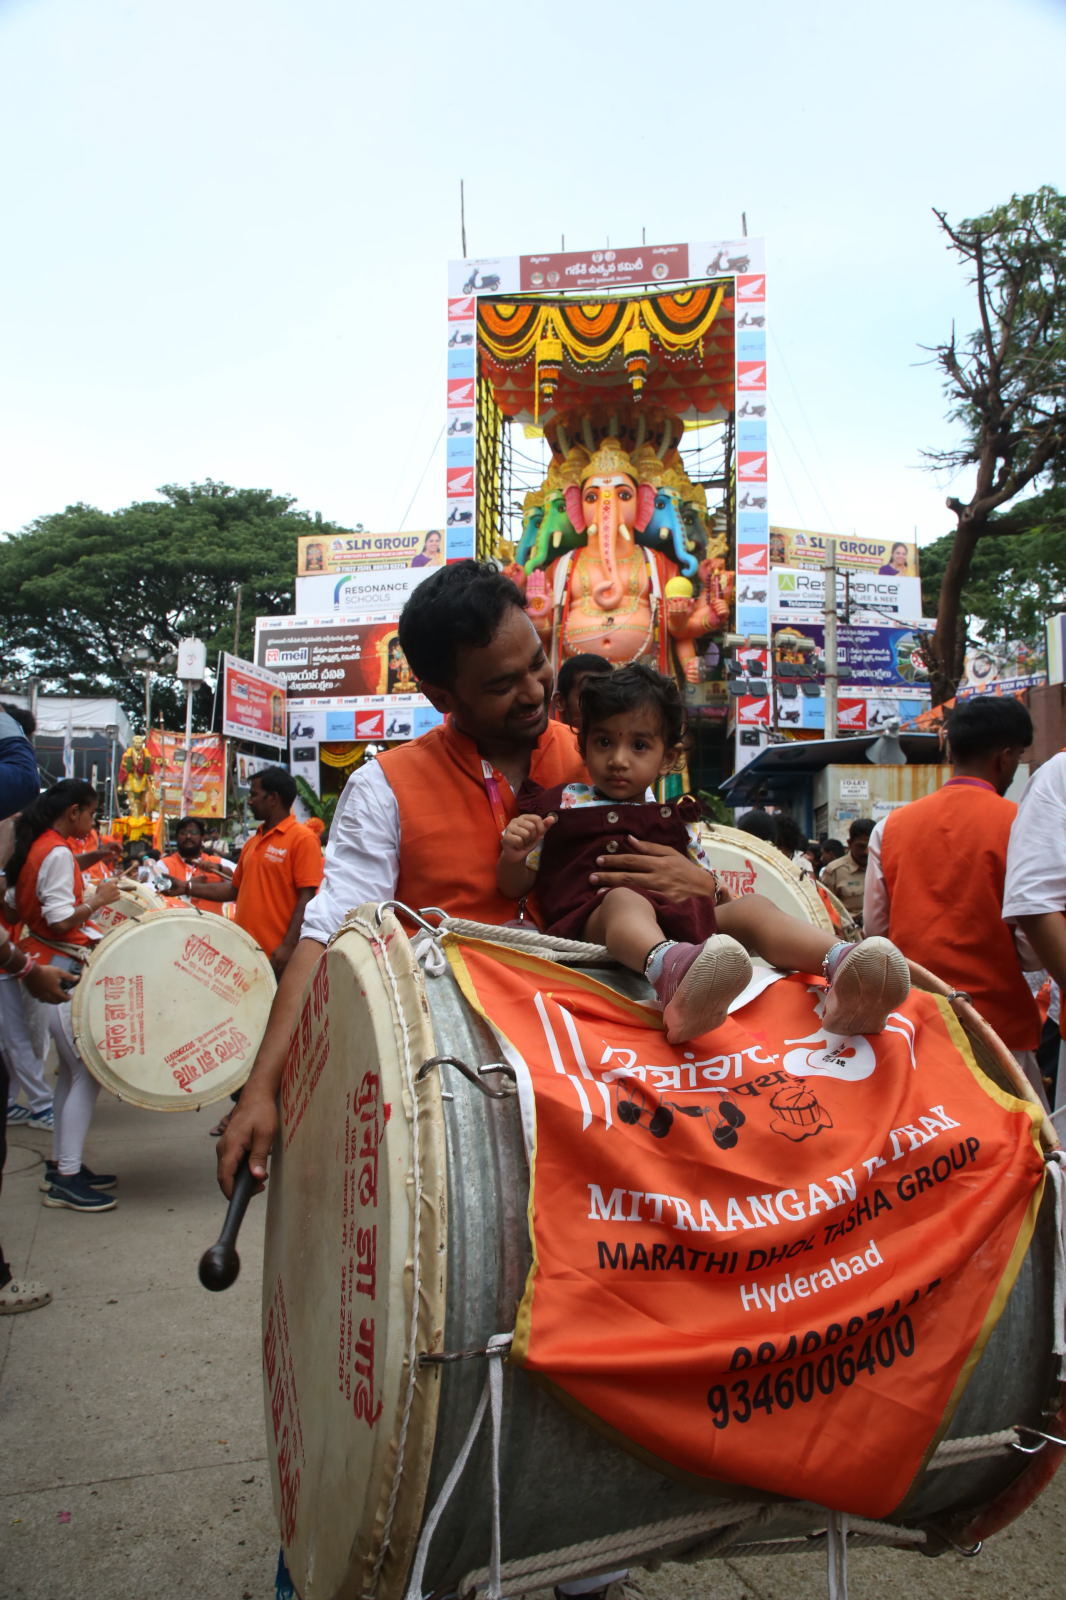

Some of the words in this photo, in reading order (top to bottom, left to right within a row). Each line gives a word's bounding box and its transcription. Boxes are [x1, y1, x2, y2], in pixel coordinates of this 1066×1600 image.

[346, 539, 372, 551] SLN
[374, 536, 419, 550] GROUP
[839, 541, 886, 556] GROUP
[345, 582, 409, 595] RESONANCE
[345, 593, 391, 605] SCHOOLS
[281, 649, 307, 660] meil
[586, 1168, 858, 1232] MITRAANGAN
[862, 1104, 961, 1182] PTHAK
[597, 1240, 739, 1275] MARATHI
[745, 1235, 816, 1272] DHOL
[823, 1188, 892, 1247] TASHA
[895, 1136, 982, 1202] GROUP
[739, 1240, 885, 1314] Hyderabad
[707, 1313, 916, 1430] 9346006400
